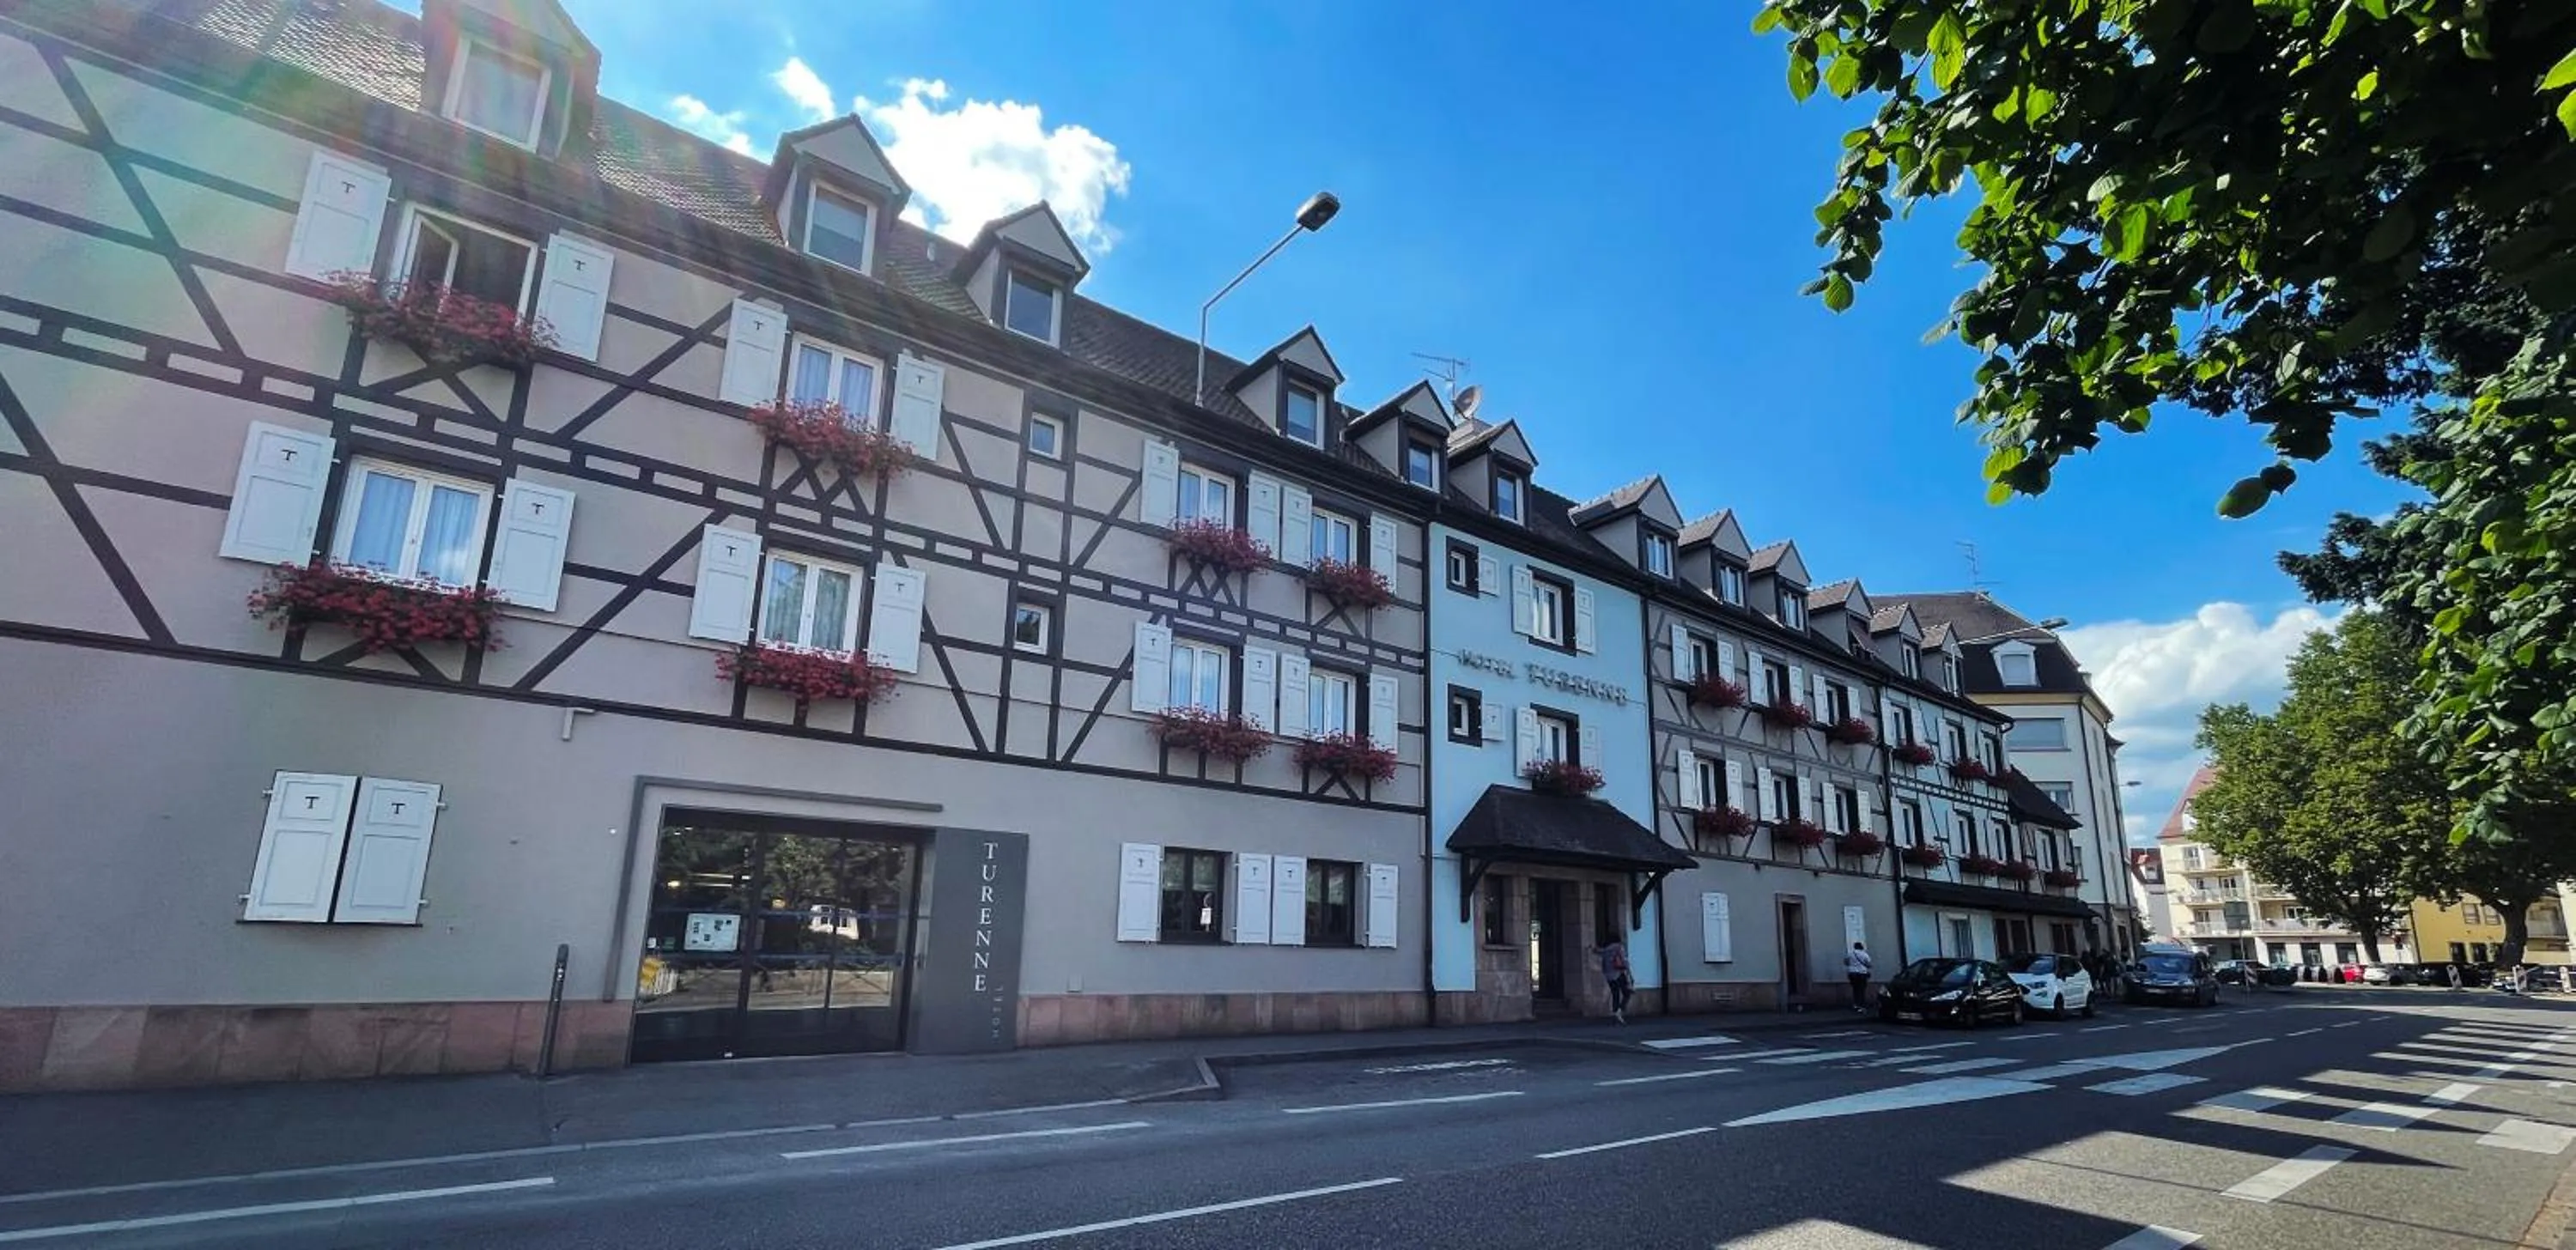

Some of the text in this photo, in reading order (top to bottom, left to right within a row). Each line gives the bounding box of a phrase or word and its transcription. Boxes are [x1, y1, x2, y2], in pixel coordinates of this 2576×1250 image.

[342, 181, 355, 193] T
[753, 320, 764, 331] T
[281, 449, 298, 461] T
[532, 502, 545, 514] T
[726, 545, 737, 557] T
[1526, 664, 1627, 705] TURENNE
[305, 796, 320, 809] T
[391, 803, 406, 815] T
[974, 842, 999, 992] TURENNE
